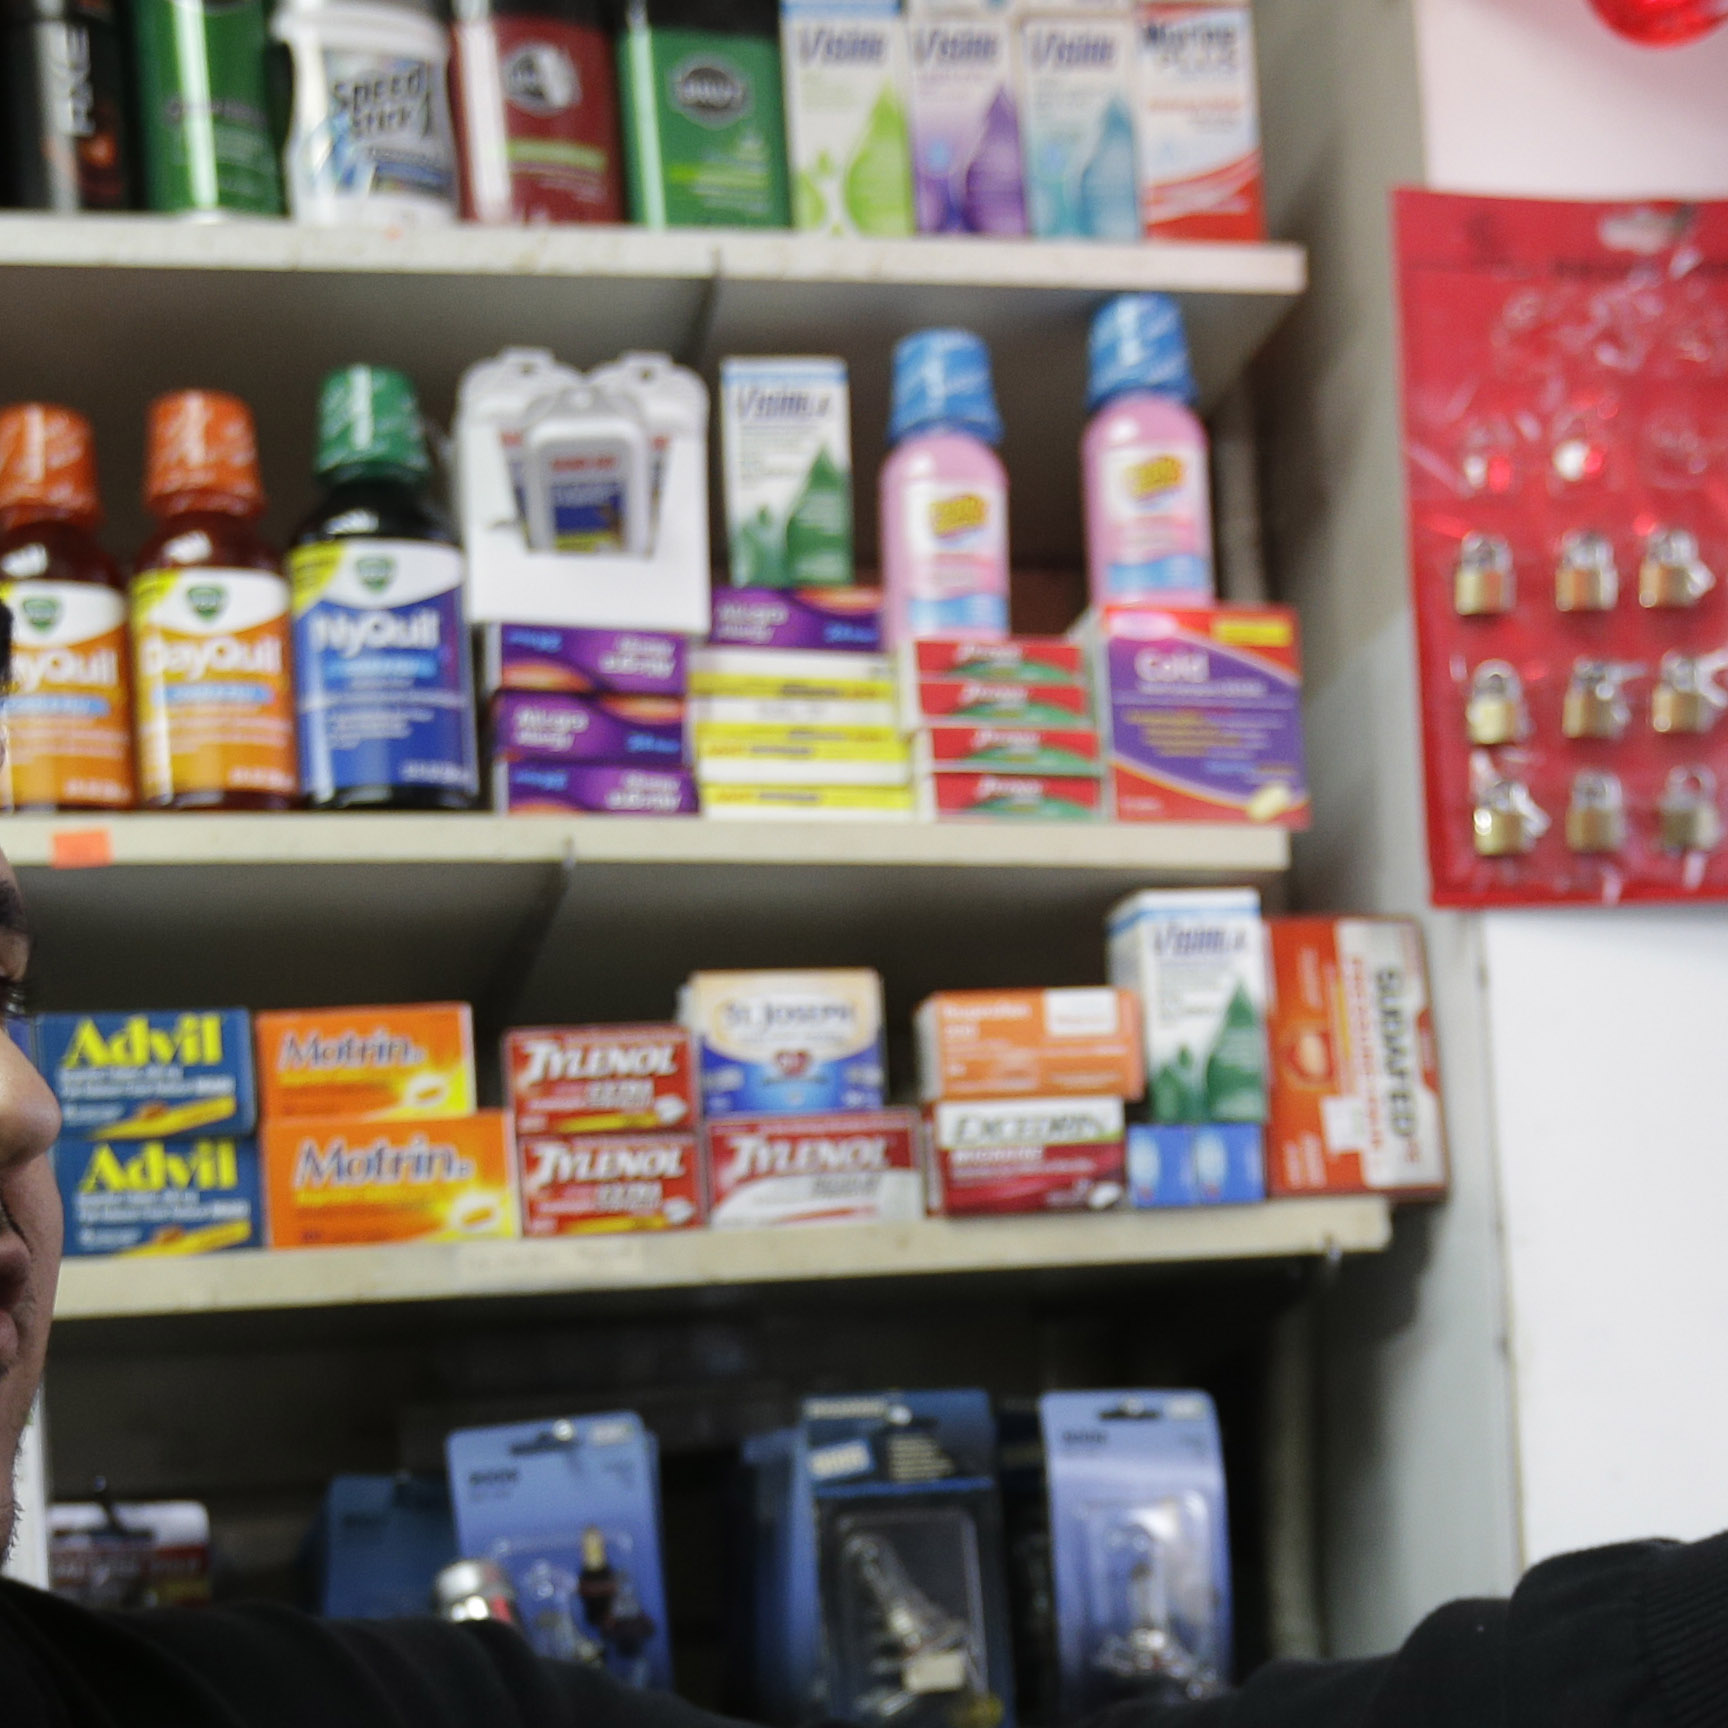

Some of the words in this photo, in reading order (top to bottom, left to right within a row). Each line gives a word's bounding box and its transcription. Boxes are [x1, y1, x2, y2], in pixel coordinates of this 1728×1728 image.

[309, 610, 441, 658] NyQuil
[61, 1012, 222, 1068] Advil
[277, 1027, 411, 1071] Motrin
[518, 1039, 678, 1086] TYLENOL
[953, 1108, 1118, 1147] EXCEDRIN
[79, 1137, 239, 1193] Advil
[293, 1134, 454, 1189] Motrin
[527, 1141, 685, 1191] TYLENOL
[720, 1134, 894, 1187] TYLENOL
